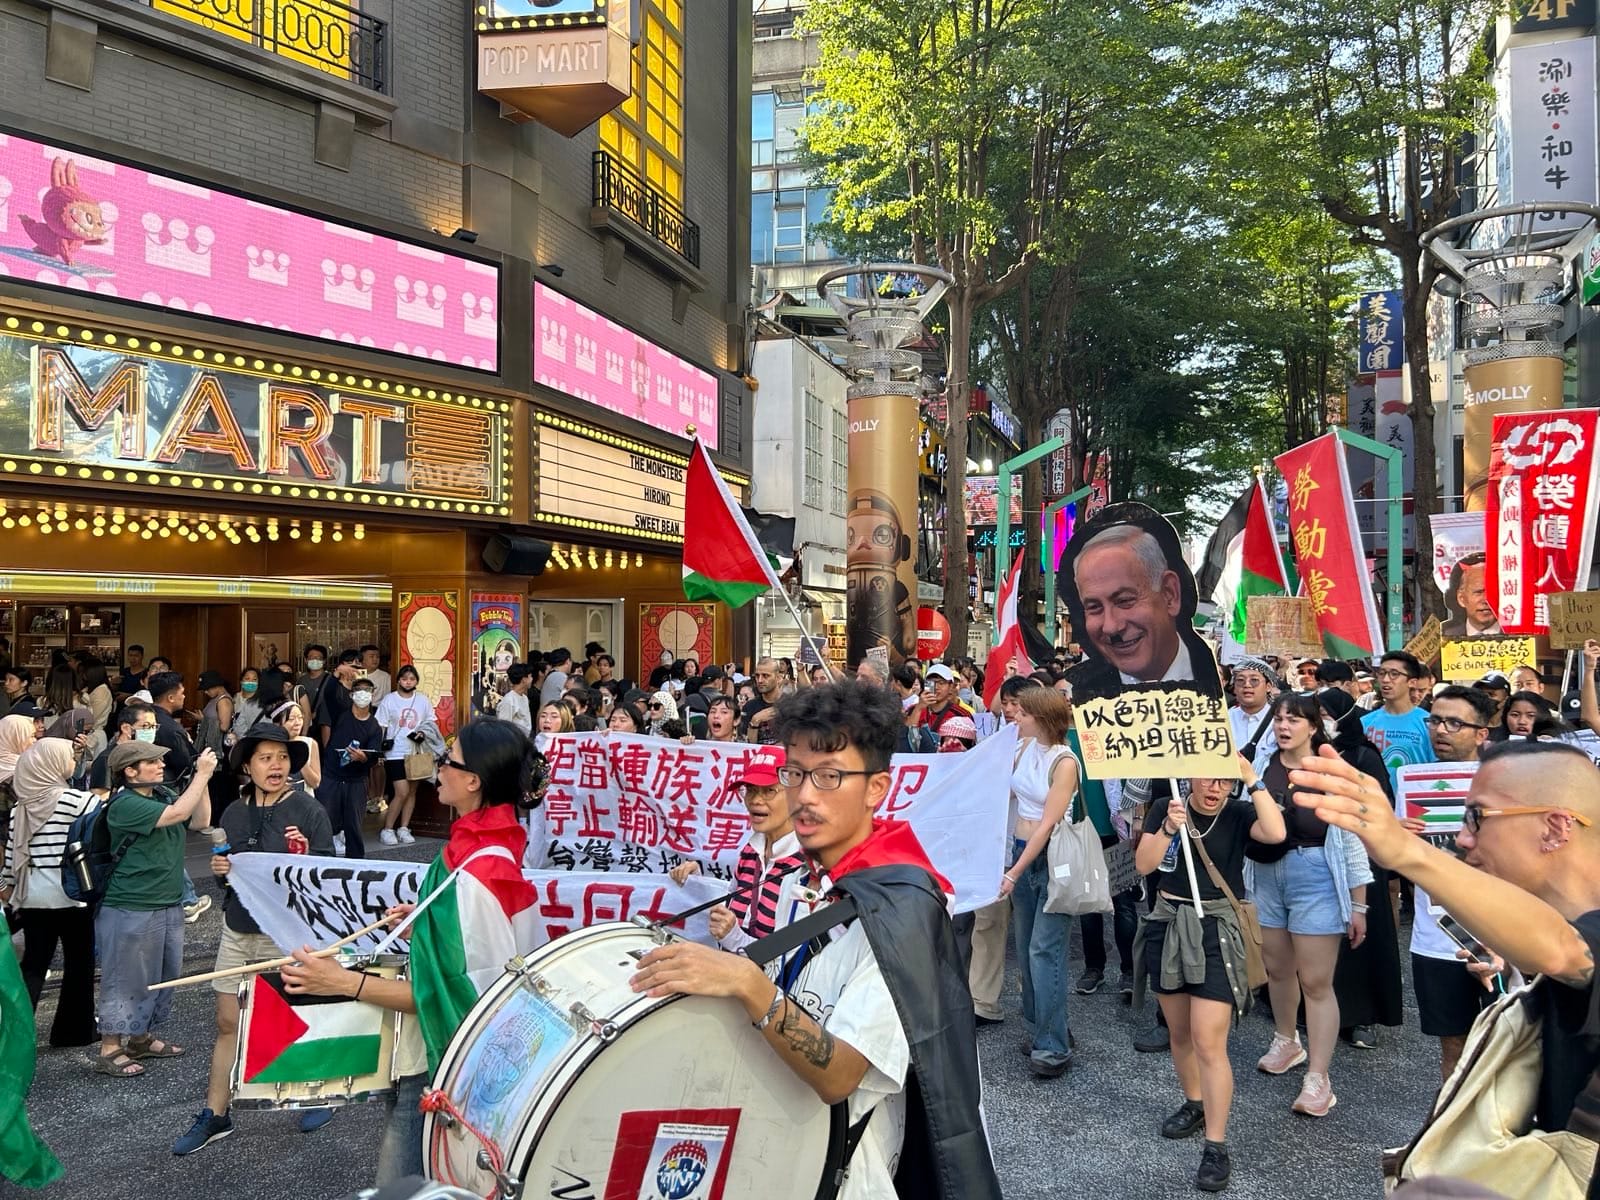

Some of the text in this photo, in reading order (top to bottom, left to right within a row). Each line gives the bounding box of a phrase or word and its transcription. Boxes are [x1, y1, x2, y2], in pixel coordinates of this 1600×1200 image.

[484, 40, 602, 76] POP MART
[1365, 294, 1394, 370] 美觀園
[1475, 385, 1533, 404] MOLLY
[30, 344, 405, 484] MART
[629, 455, 682, 482] THE MONSTERS
[644, 487, 671, 506] HIRONO
[635, 514, 680, 534] SWEET BEAN
[1291, 462, 1338, 618] 勞動黨
[1083, 695, 1226, 729] 以色列總理
[1105, 726, 1232, 760] 納坦雅胡
